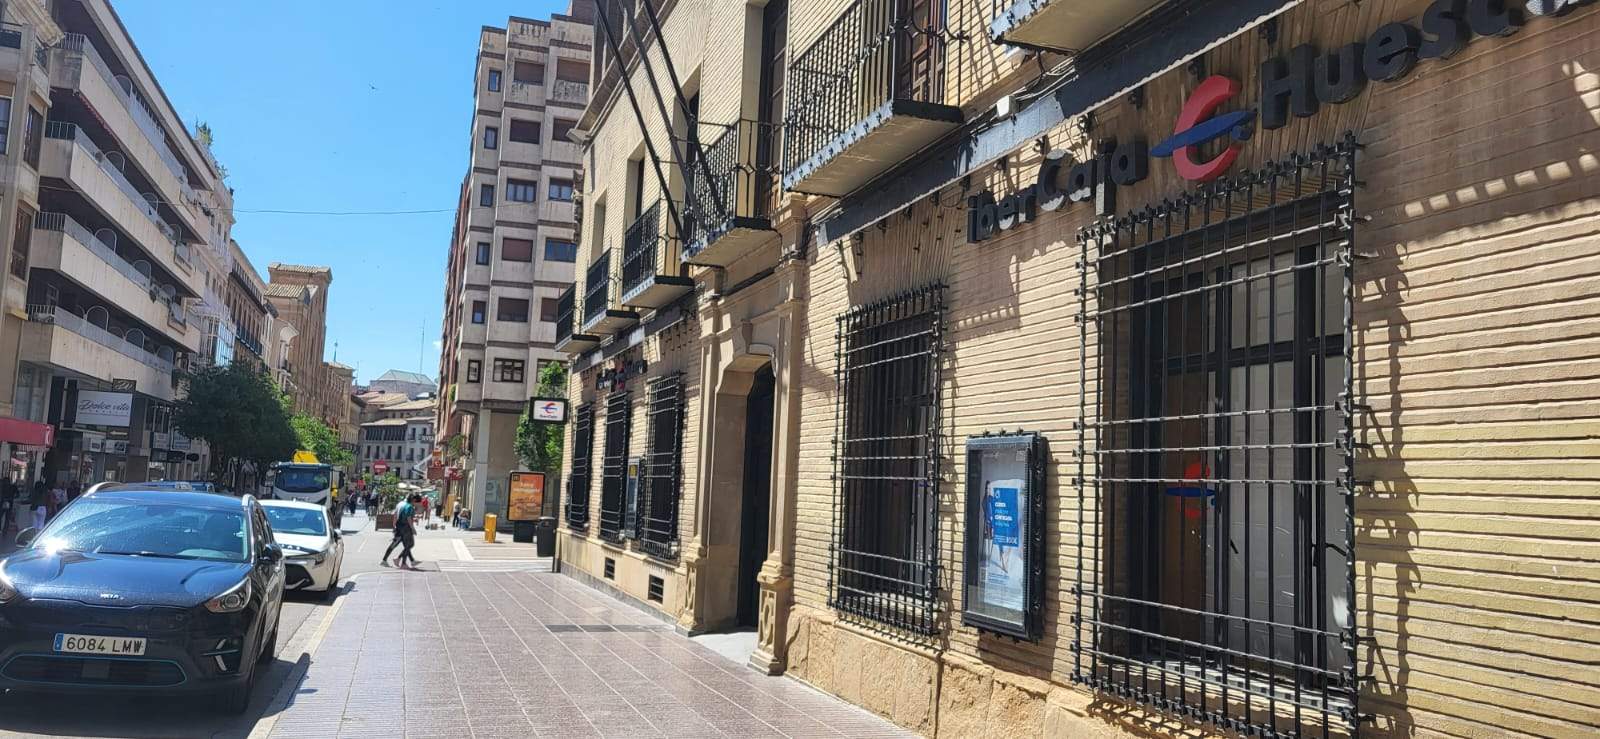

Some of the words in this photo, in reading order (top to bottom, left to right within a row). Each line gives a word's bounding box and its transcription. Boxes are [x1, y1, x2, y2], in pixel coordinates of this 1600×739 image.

[1261, 0, 1590, 129] Huesc
[66, 636, 106, 651] 6084
[112, 640, 142, 653] LMW
